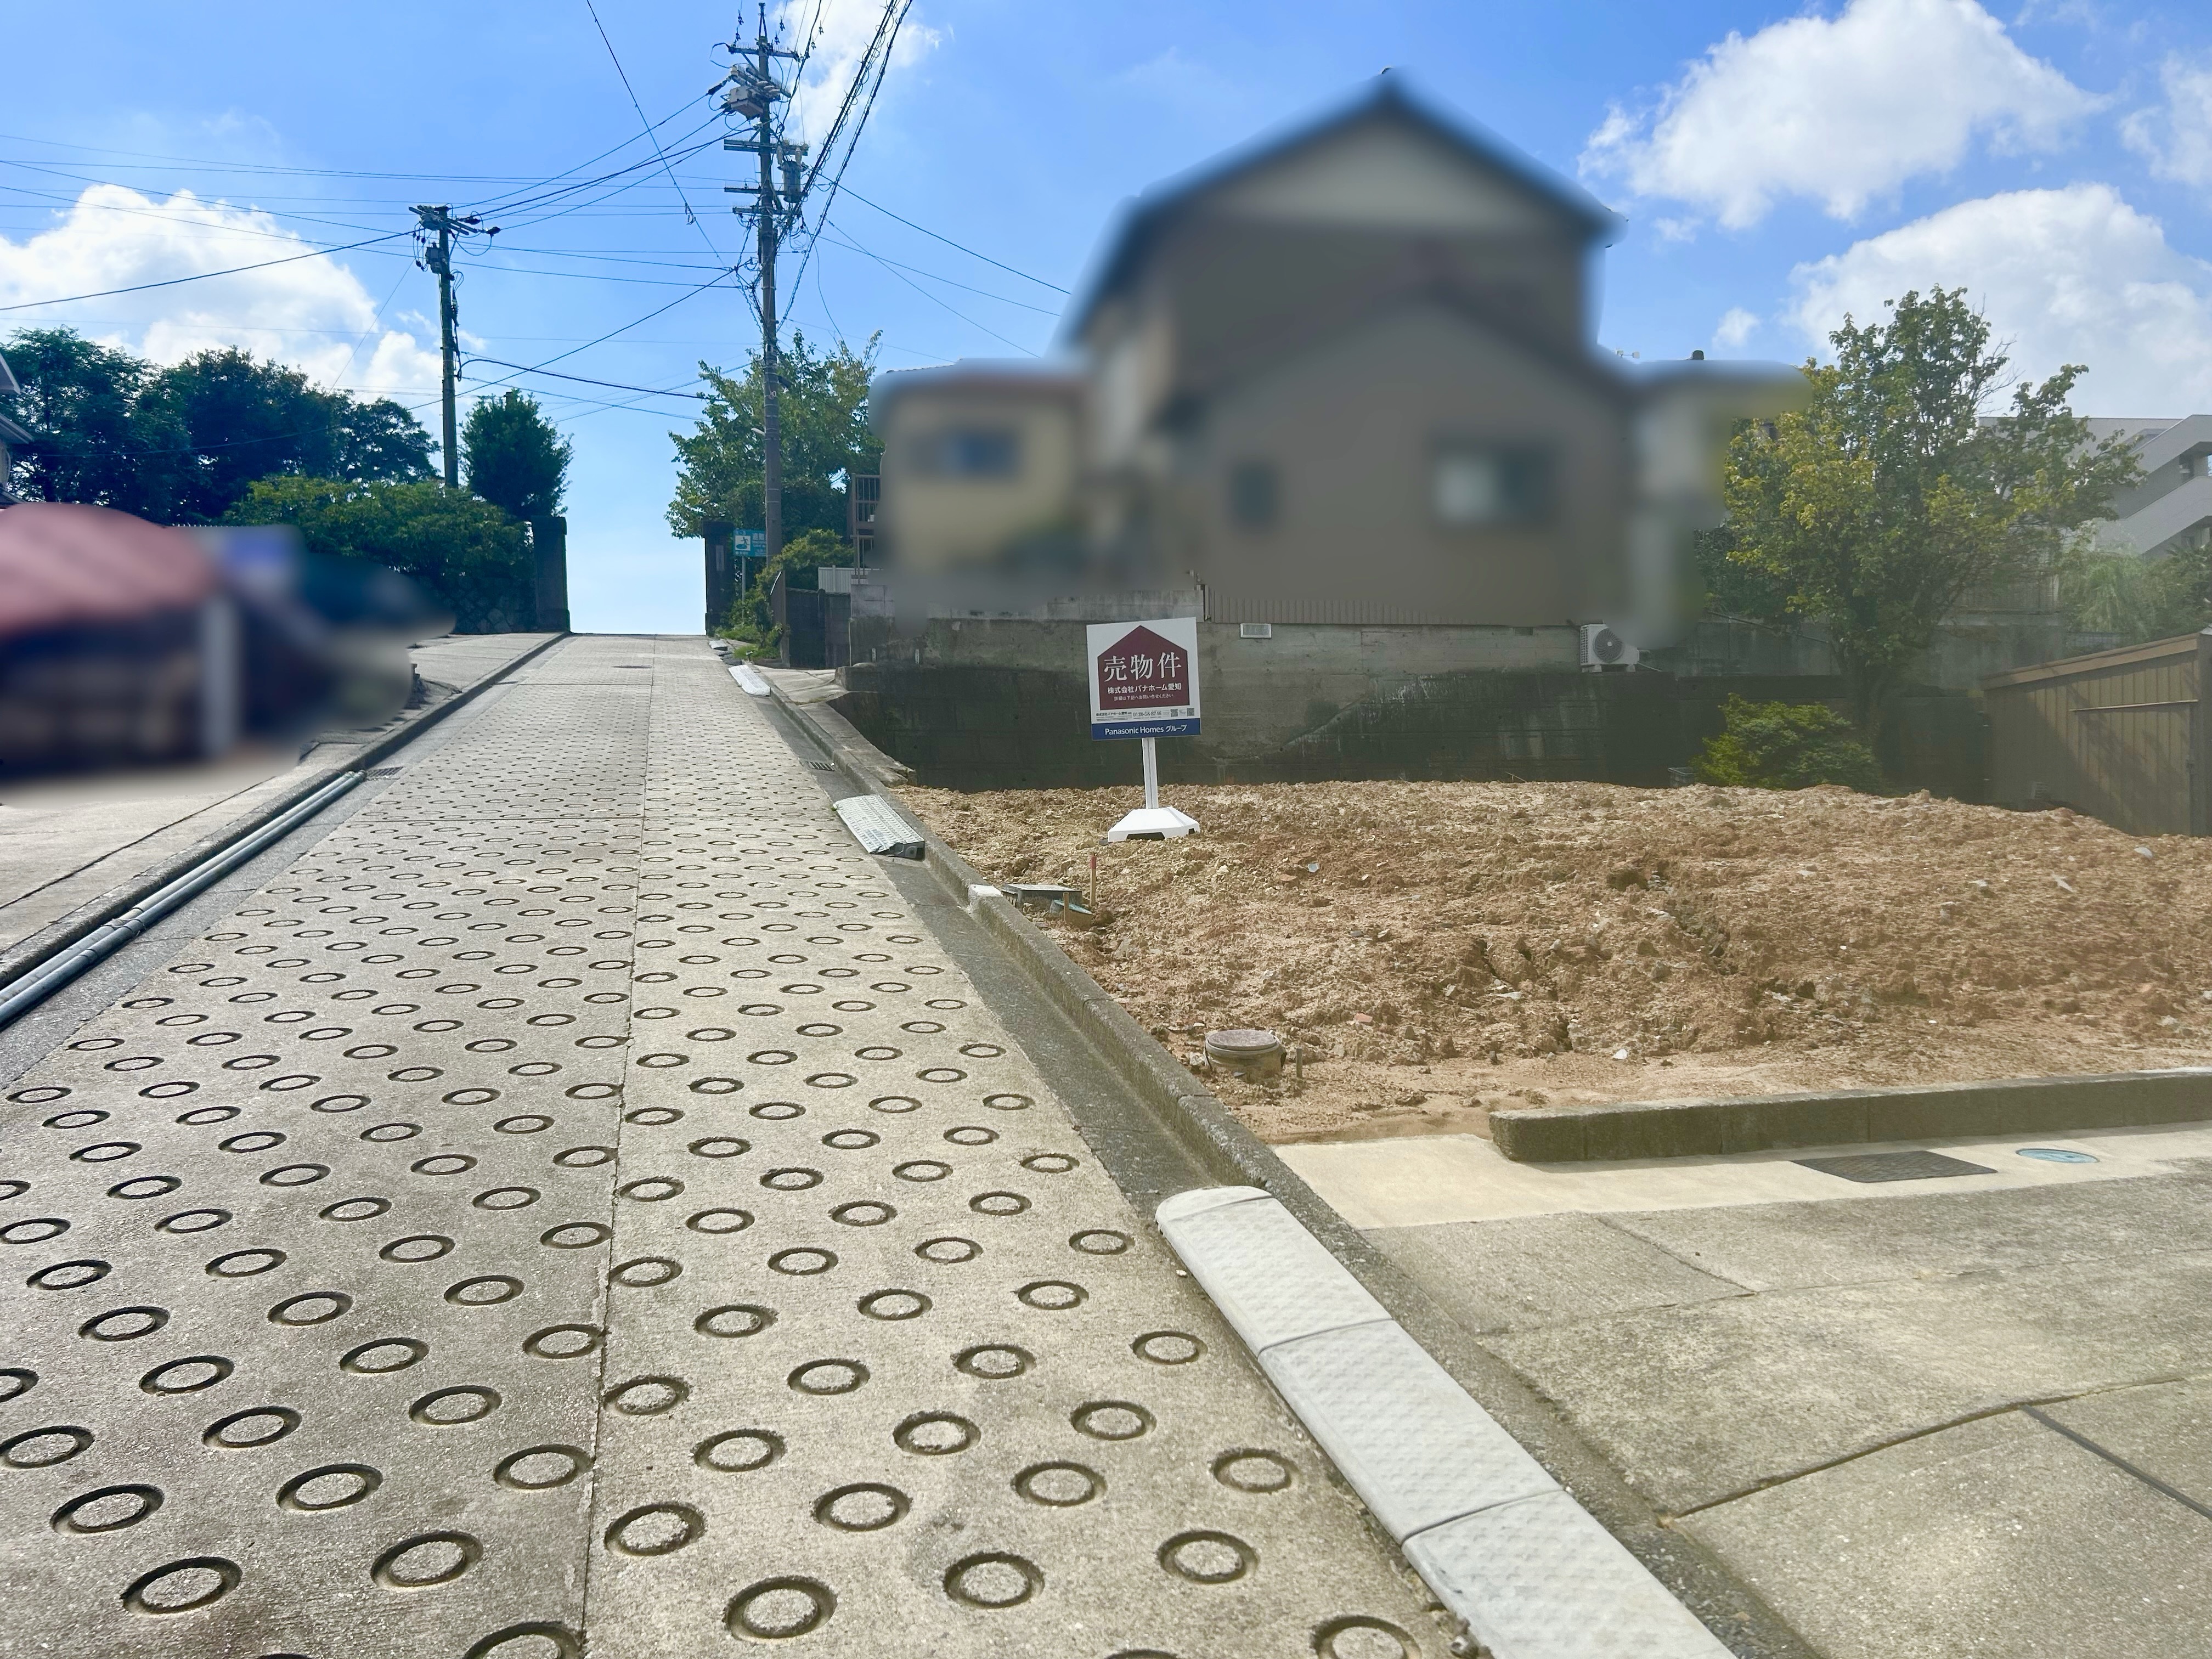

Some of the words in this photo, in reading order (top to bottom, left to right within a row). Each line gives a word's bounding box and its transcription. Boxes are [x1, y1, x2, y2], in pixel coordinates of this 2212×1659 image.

[1104, 652, 1182, 681] 売物件
[1108, 682, 1182, 694] 株式会社パナホーム愛知
[1105, 727, 1139, 735] Panasonic
[1165, 724, 1187, 732] グループ
